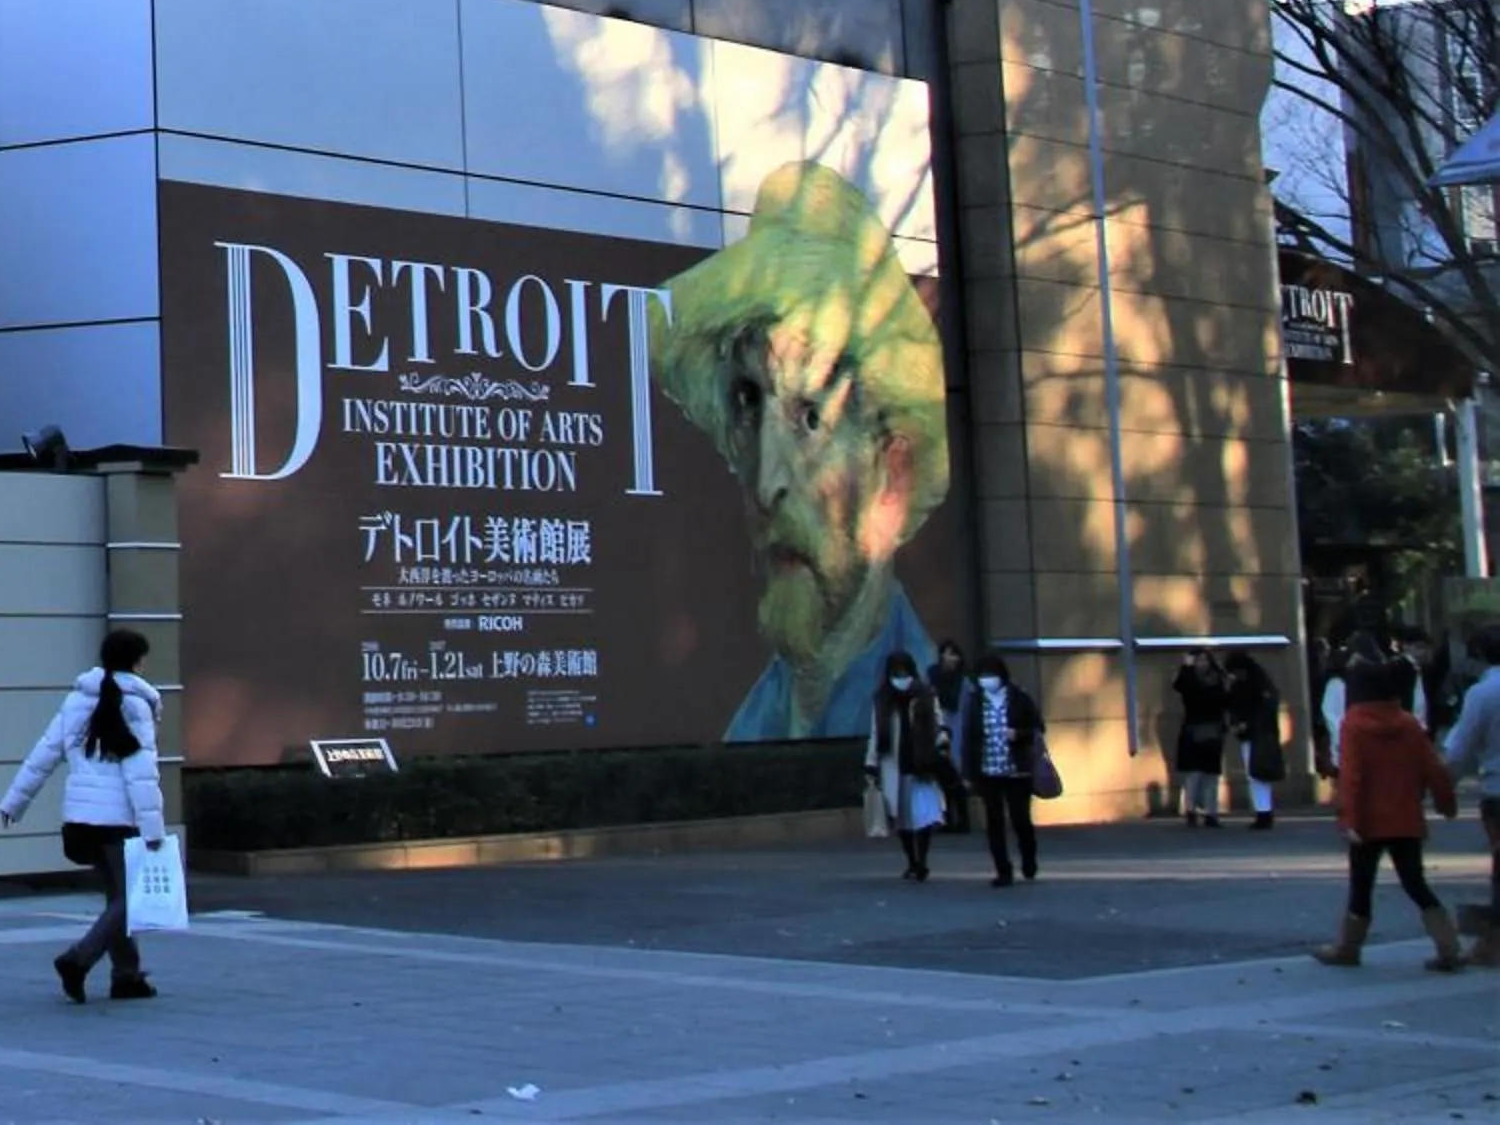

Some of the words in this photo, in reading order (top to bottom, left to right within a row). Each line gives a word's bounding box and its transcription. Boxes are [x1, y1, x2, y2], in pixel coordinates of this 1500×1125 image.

[1279, 284, 1354, 365] TROIT
[213, 241, 673, 496] DETROIT
[342, 398, 488, 441] INSTITUTE
[498, 409, 531, 440] OF
[540, 411, 603, 446] ARTS
[375, 441, 577, 492] EXHIBITION
[358, 511, 592, 564] デトロイト美術館展
[479, 616, 522, 631] RICOH
[492, 650, 597, 679] 上野の森美術館
